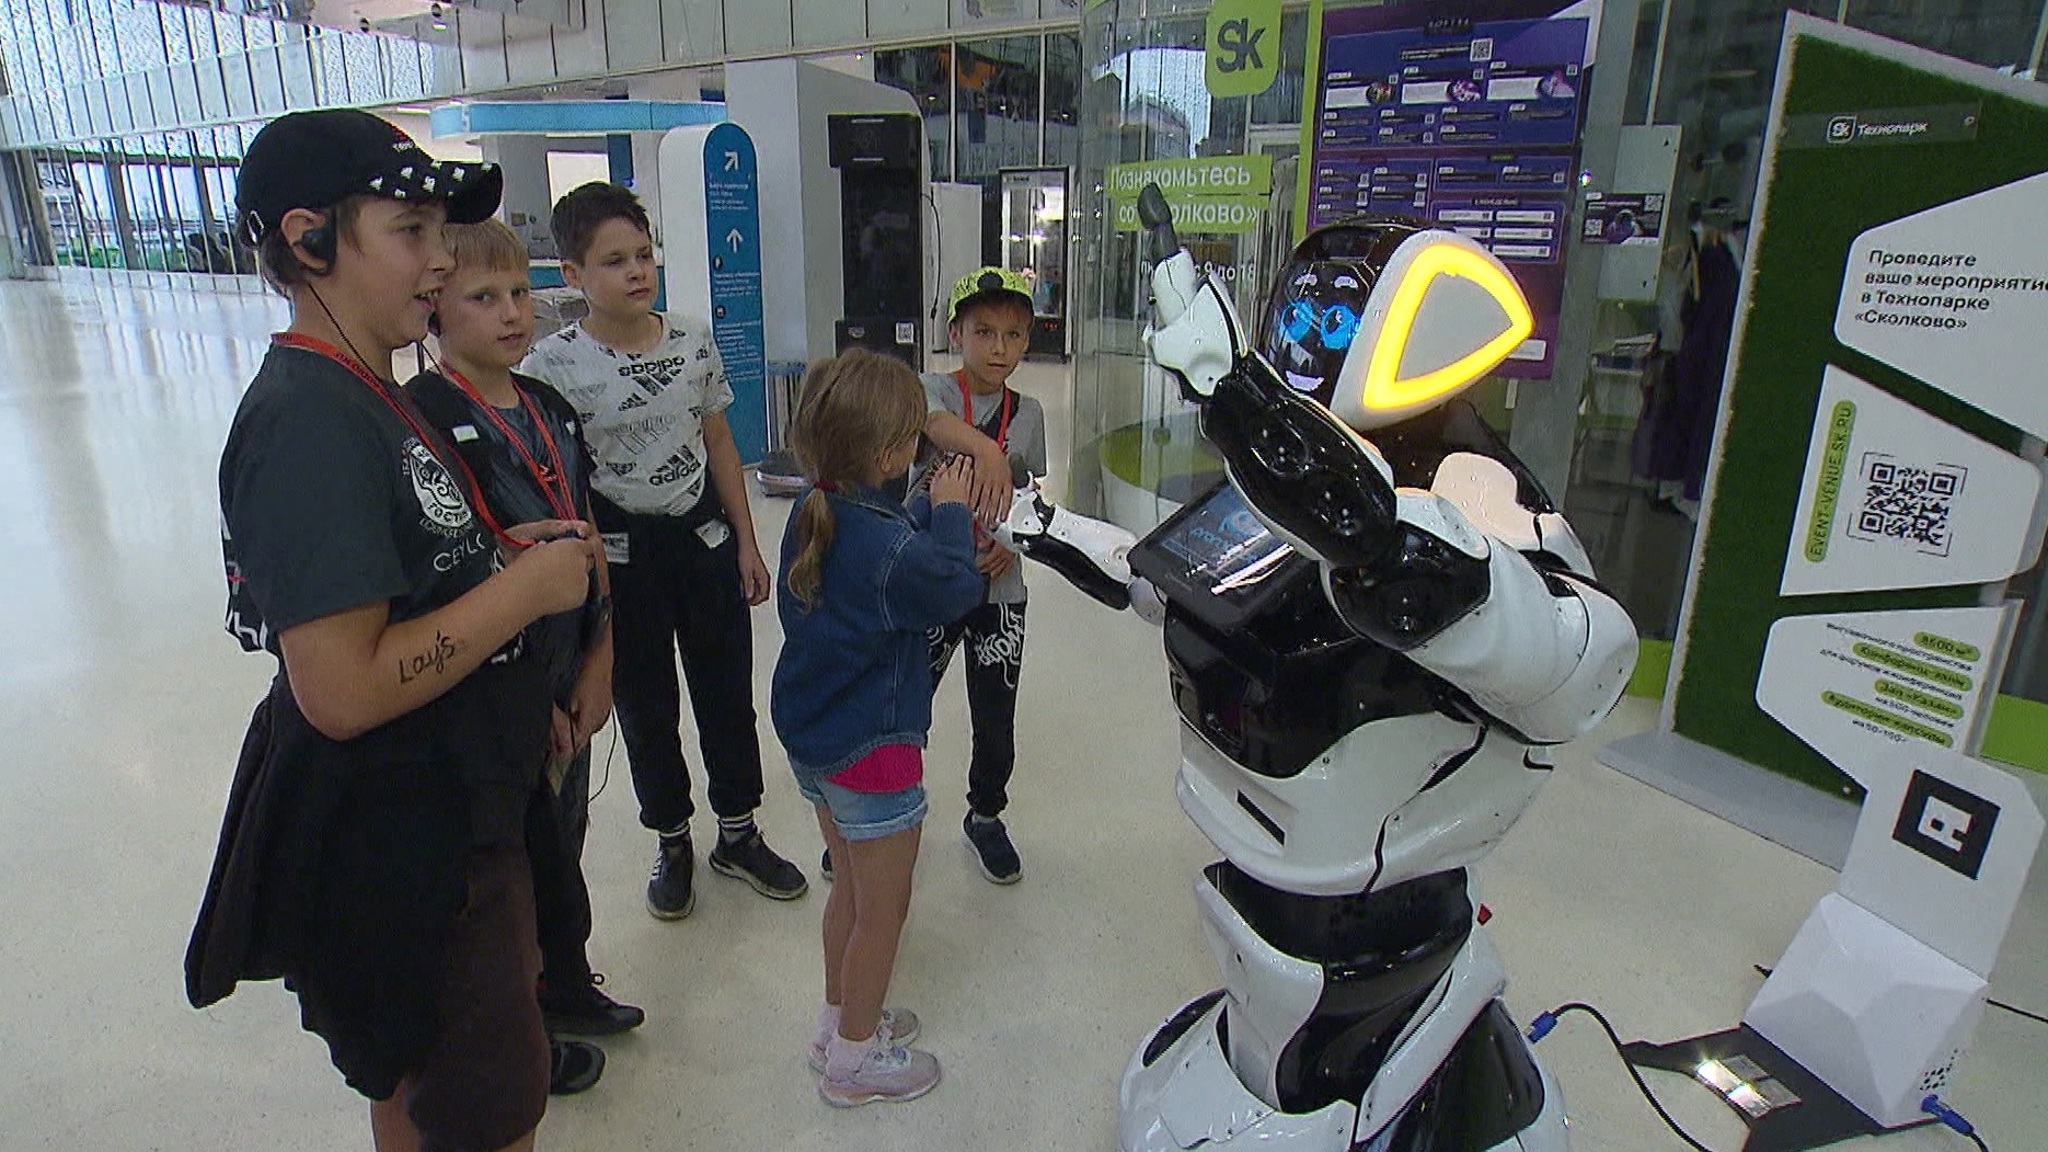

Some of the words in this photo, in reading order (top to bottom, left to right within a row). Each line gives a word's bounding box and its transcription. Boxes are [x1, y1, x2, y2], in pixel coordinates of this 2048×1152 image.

[1216, 17, 1267, 73] Sk
[1857, 122, 1929, 137] Технопарк
[1110, 165, 1251, 191] Познакомьтесь
[1172, 204, 1258, 225] олково»
[1868, 249, 1977, 267] Проведите
[1864, 271, 1913, 287] ваше
[1861, 291, 1872, 304] в
[1876, 289, 1990, 312] Технопарке
[1854, 308, 1968, 329] «Сколково»
[399, 629, 456, 684] Lay's
